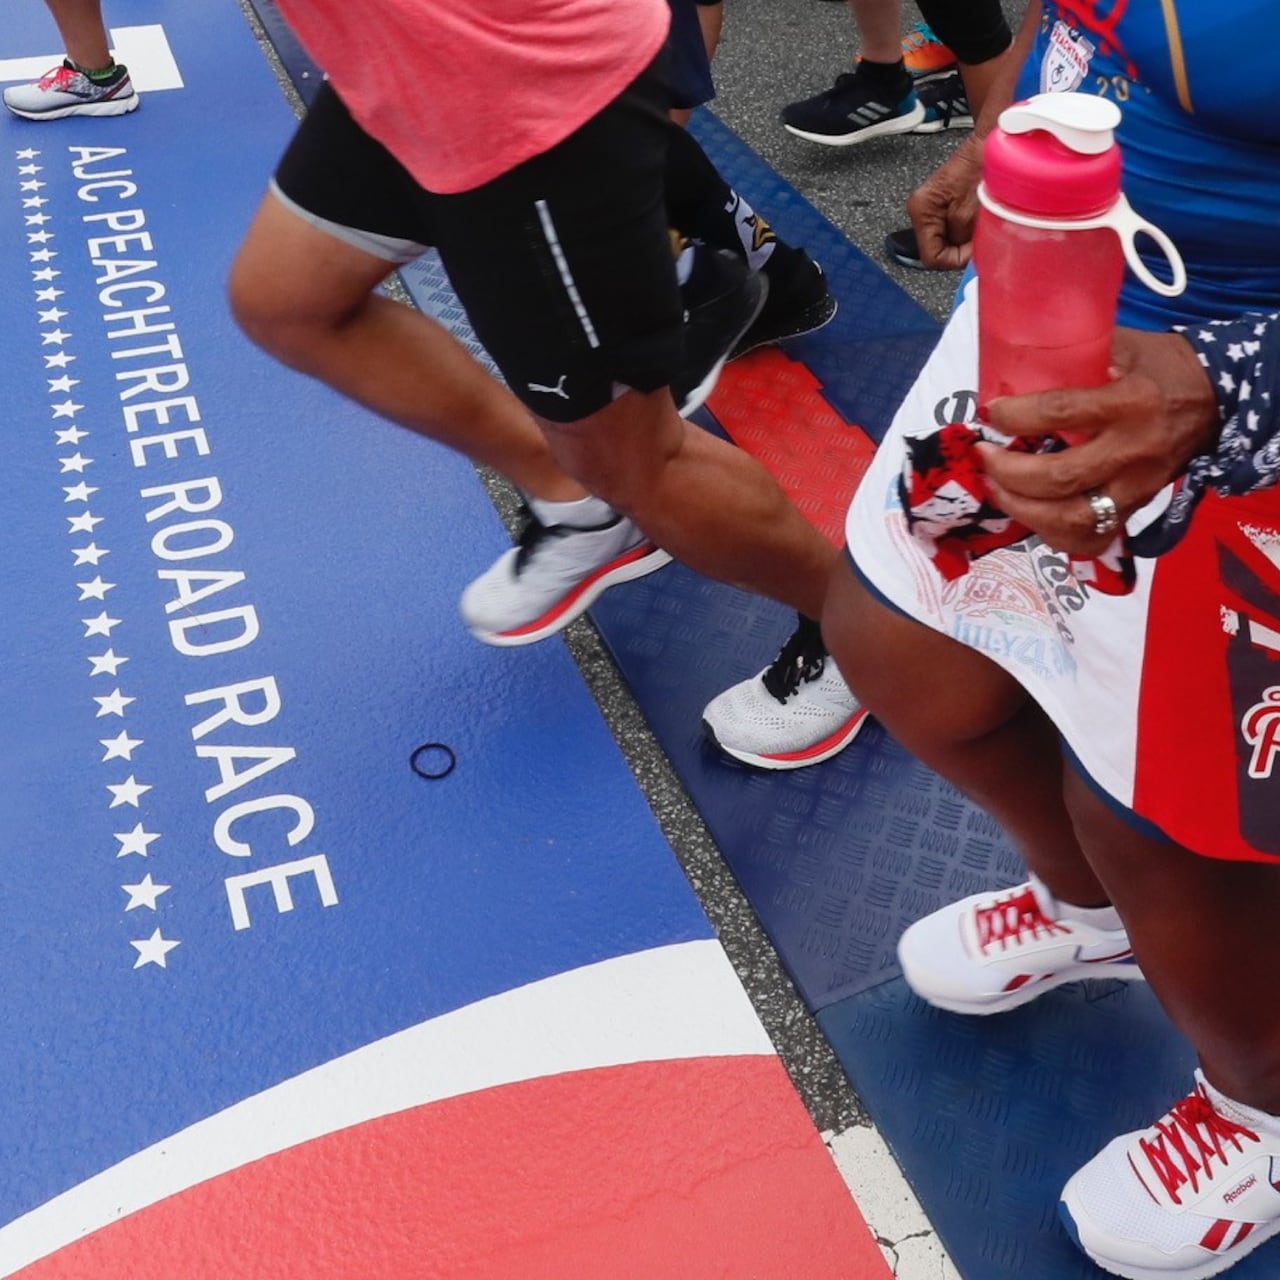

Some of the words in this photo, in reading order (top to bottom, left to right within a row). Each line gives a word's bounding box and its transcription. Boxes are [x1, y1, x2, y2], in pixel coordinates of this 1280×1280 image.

[68, 145, 138, 203] AJC
[82, 209, 211, 467] PEACHTREE
[139, 476, 261, 656] ROAD
[184, 675, 340, 931] RACE
[1223, 1175, 1257, 1203] Reebok
